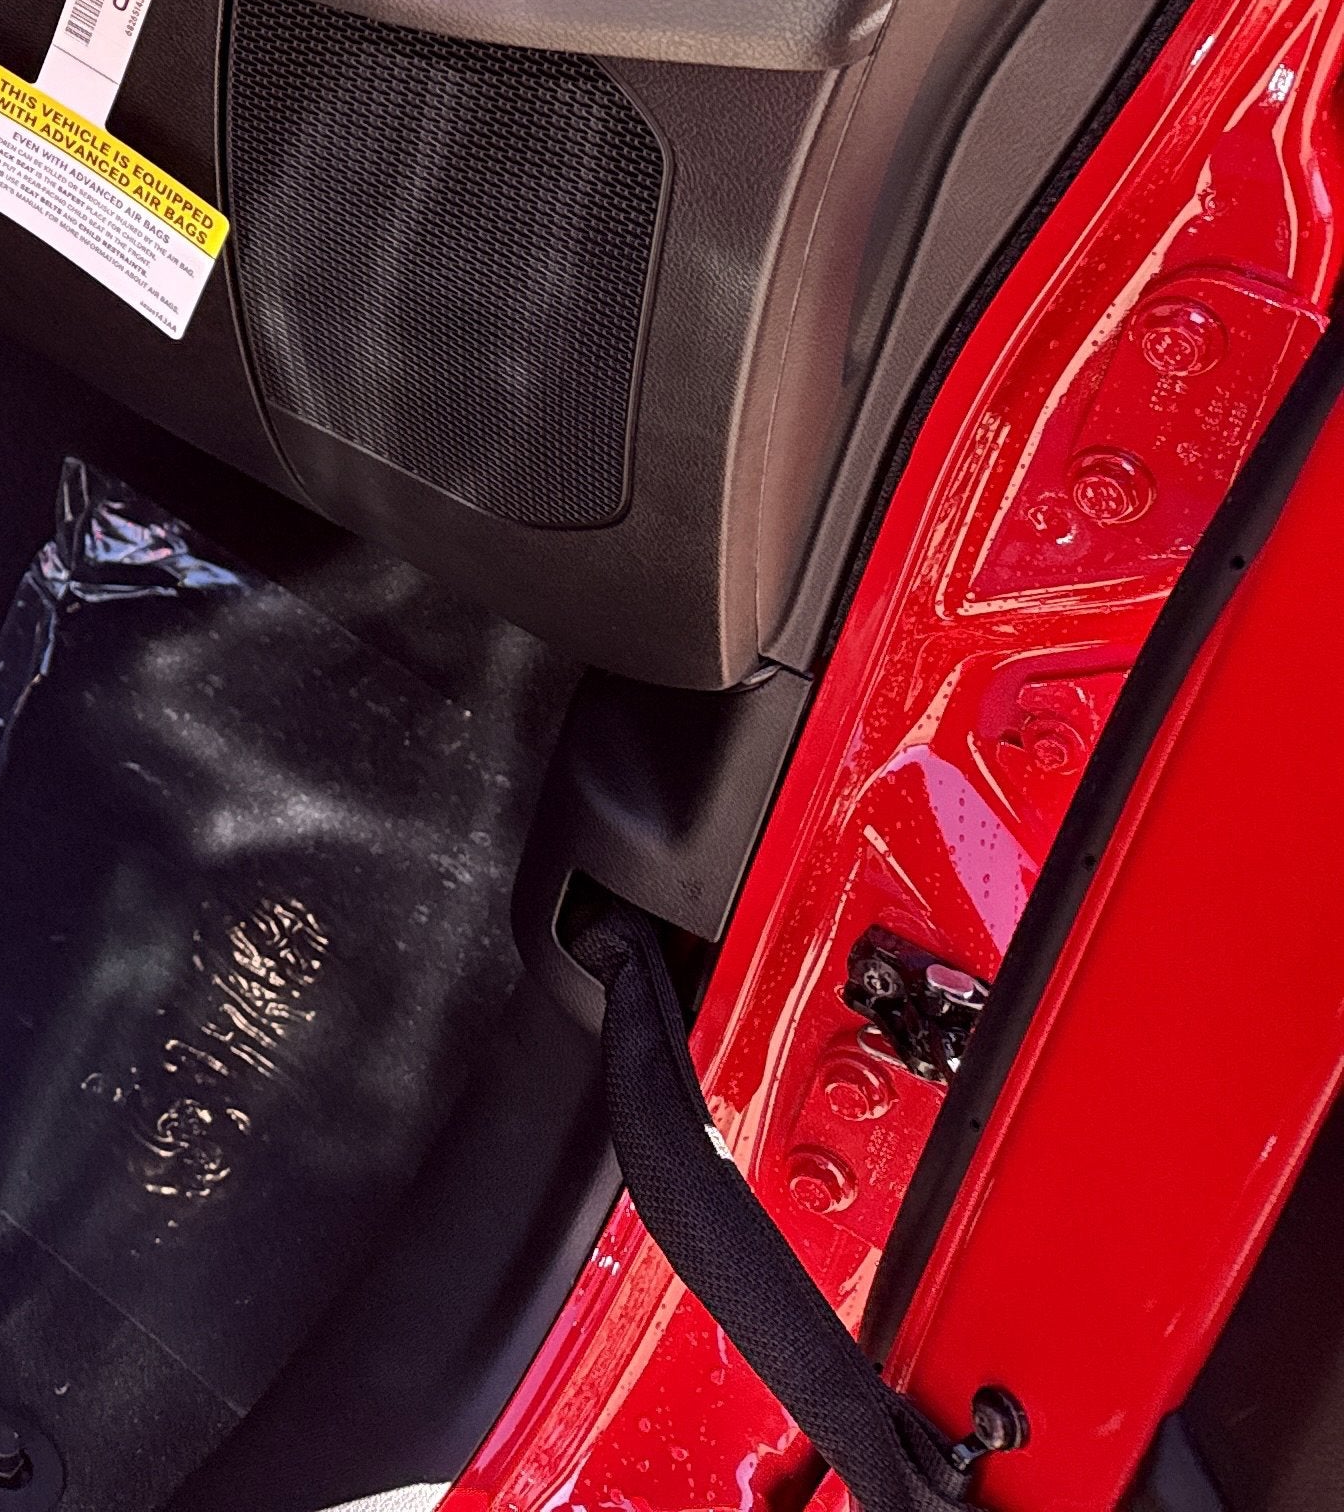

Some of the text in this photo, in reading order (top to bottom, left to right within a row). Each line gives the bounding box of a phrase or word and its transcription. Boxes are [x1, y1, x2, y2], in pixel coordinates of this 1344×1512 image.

[2, 160, 15, 173] PUT
[23, 174, 66, 206] REAR-FACING
[66, 203, 87, 221] CHILD
[88, 218, 104, 233] SEAT
[104, 230, 113, 239] IN
[113, 236, 127, 250] THE
[4, 173, 19, 186] USE
[19, 182, 38, 199] SEAT
[39, 196, 62, 215] BELTS
[62, 211, 77, 225] AND
[78, 222, 101, 242] CHILD
[12, 131, 170, 244] EVEN WITH ADVANCED AIR BAGS
[15, 158, 35, 175] SEAT
[43, 175, 56, 188] THE
[57, 185, 85, 207] SAFEST
[85, 204, 106, 223] PLACE
[107, 220, 121, 234] FOR
[17, 148, 32, 162] CAN
[33, 158, 42, 168] BE
[43, 164, 67, 184] KILLED
[67, 180, 77, 191] OR
[78, 188, 114, 217] SERIOUSLY
[114, 214, 142, 238] INJURED
[143, 234, 153, 245] BY
[153, 242, 166, 256] THE
[166, 253, 179, 265] AIR
[179, 261, 195, 278] BAG.
[39, 103, 111, 156] VEHICLE
[112, 149, 130, 170] IS
[131, 163, 214, 231] EQUIPPED
[39, 120, 131, 189] ADVANCED
[132, 182, 161, 211] AIR
[163, 205, 208, 246] BAGS
[15, 191, 43, 213] MANUAL
[44, 210, 58, 224] FOR
[59, 220, 79, 238] MORE
[78, 234, 124, 272] INFORMATION
[124, 268, 147, 289] ABOUT
[147, 286, 159, 298] AIR
